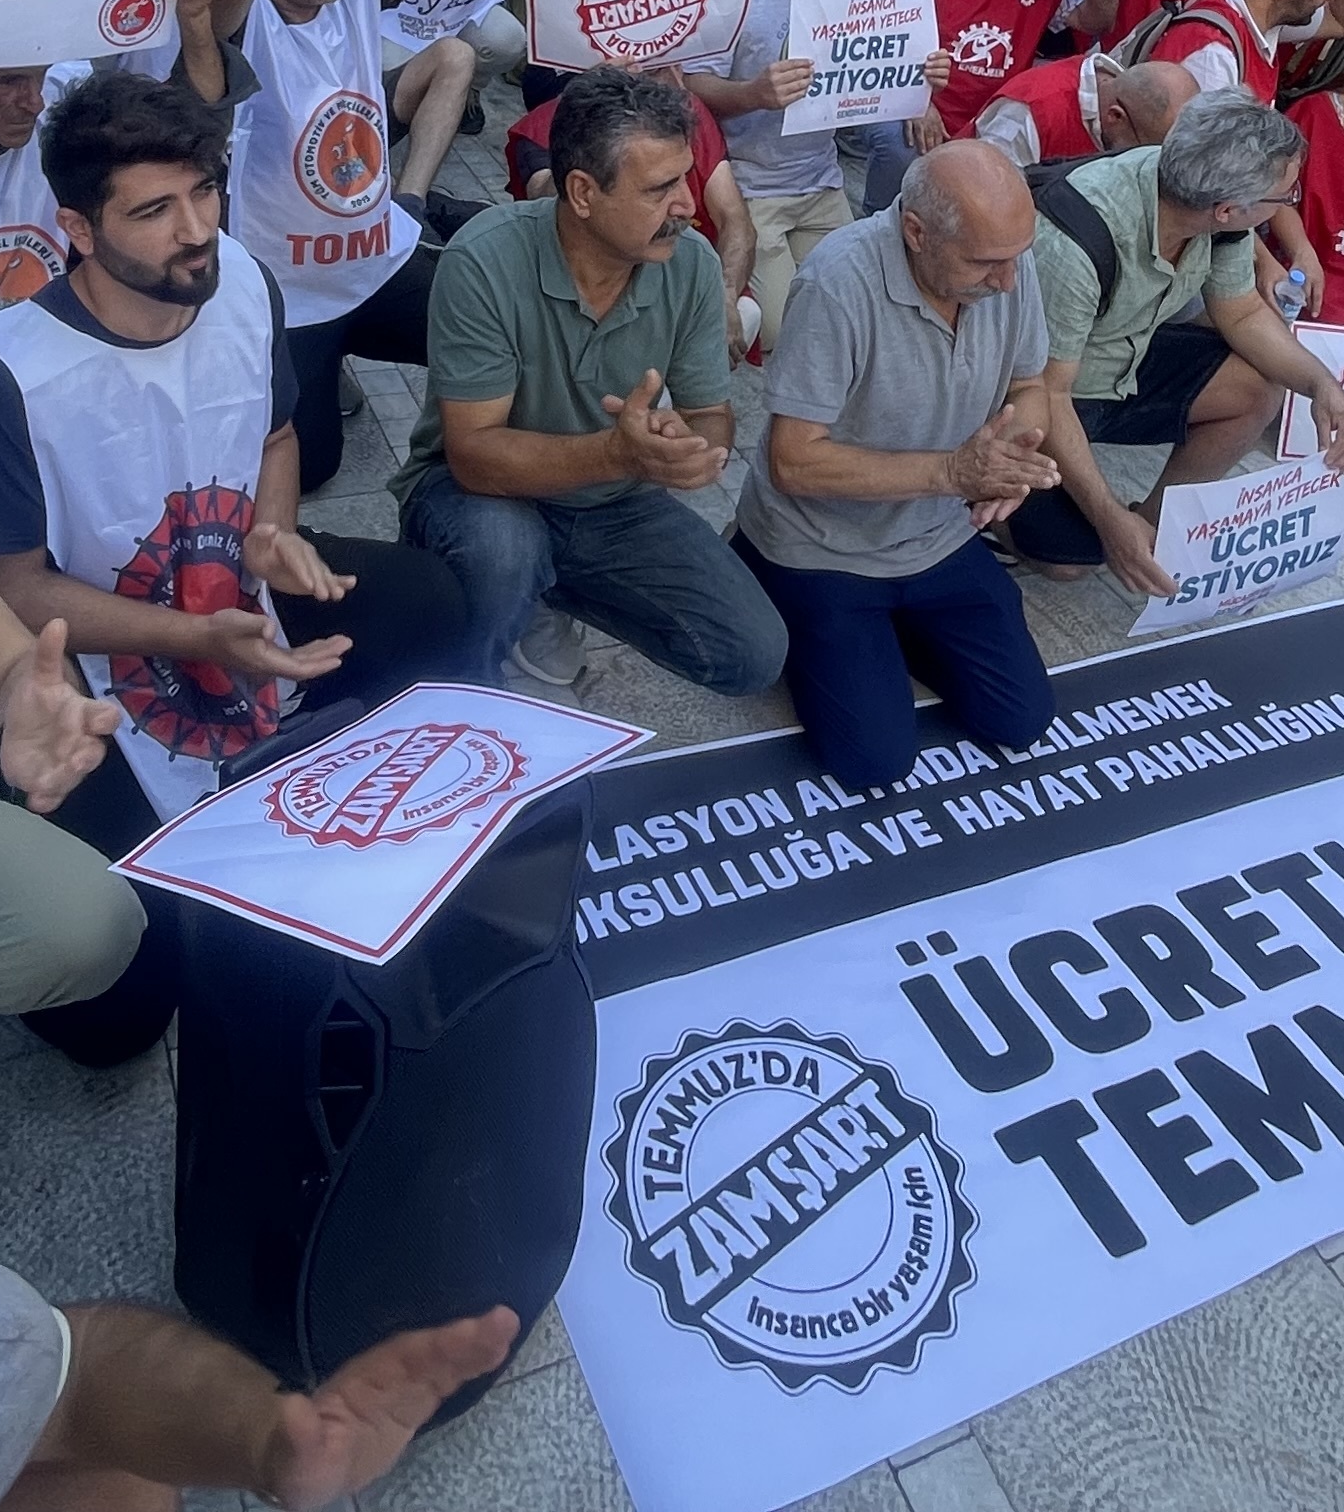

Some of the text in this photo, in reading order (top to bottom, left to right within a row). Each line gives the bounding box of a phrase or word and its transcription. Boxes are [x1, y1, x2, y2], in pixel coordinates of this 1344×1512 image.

[812, 6, 923, 42] YAŞAMAYA YETECEK
[831, 31, 910, 63] ÜCRET
[807, 63, 926, 98] STİYORUZ
[286, 211, 390, 265] TOMİ
[1186, 473, 1341, 544] YAŞAMAYA YETECEK
[1236, 466, 1302, 508] İNSANCA
[1211, 505, 1316, 562] ÜCRET
[1165, 536, 1341, 606] İSTİYORUZ
[293, 740, 394, 819] TEMMUZ'DA
[575, 829, 873, 945] KSULLUĞA
[861, 808, 944, 857] VE
[943, 765, 1104, 836] HAYAT
[585, 789, 794, 873] LASYON
[642, 1050, 821, 1201] TEMMUZ'DA
[853, 1287, 895, 1327] bir
[888, 1213, 934, 1302] yaşam
